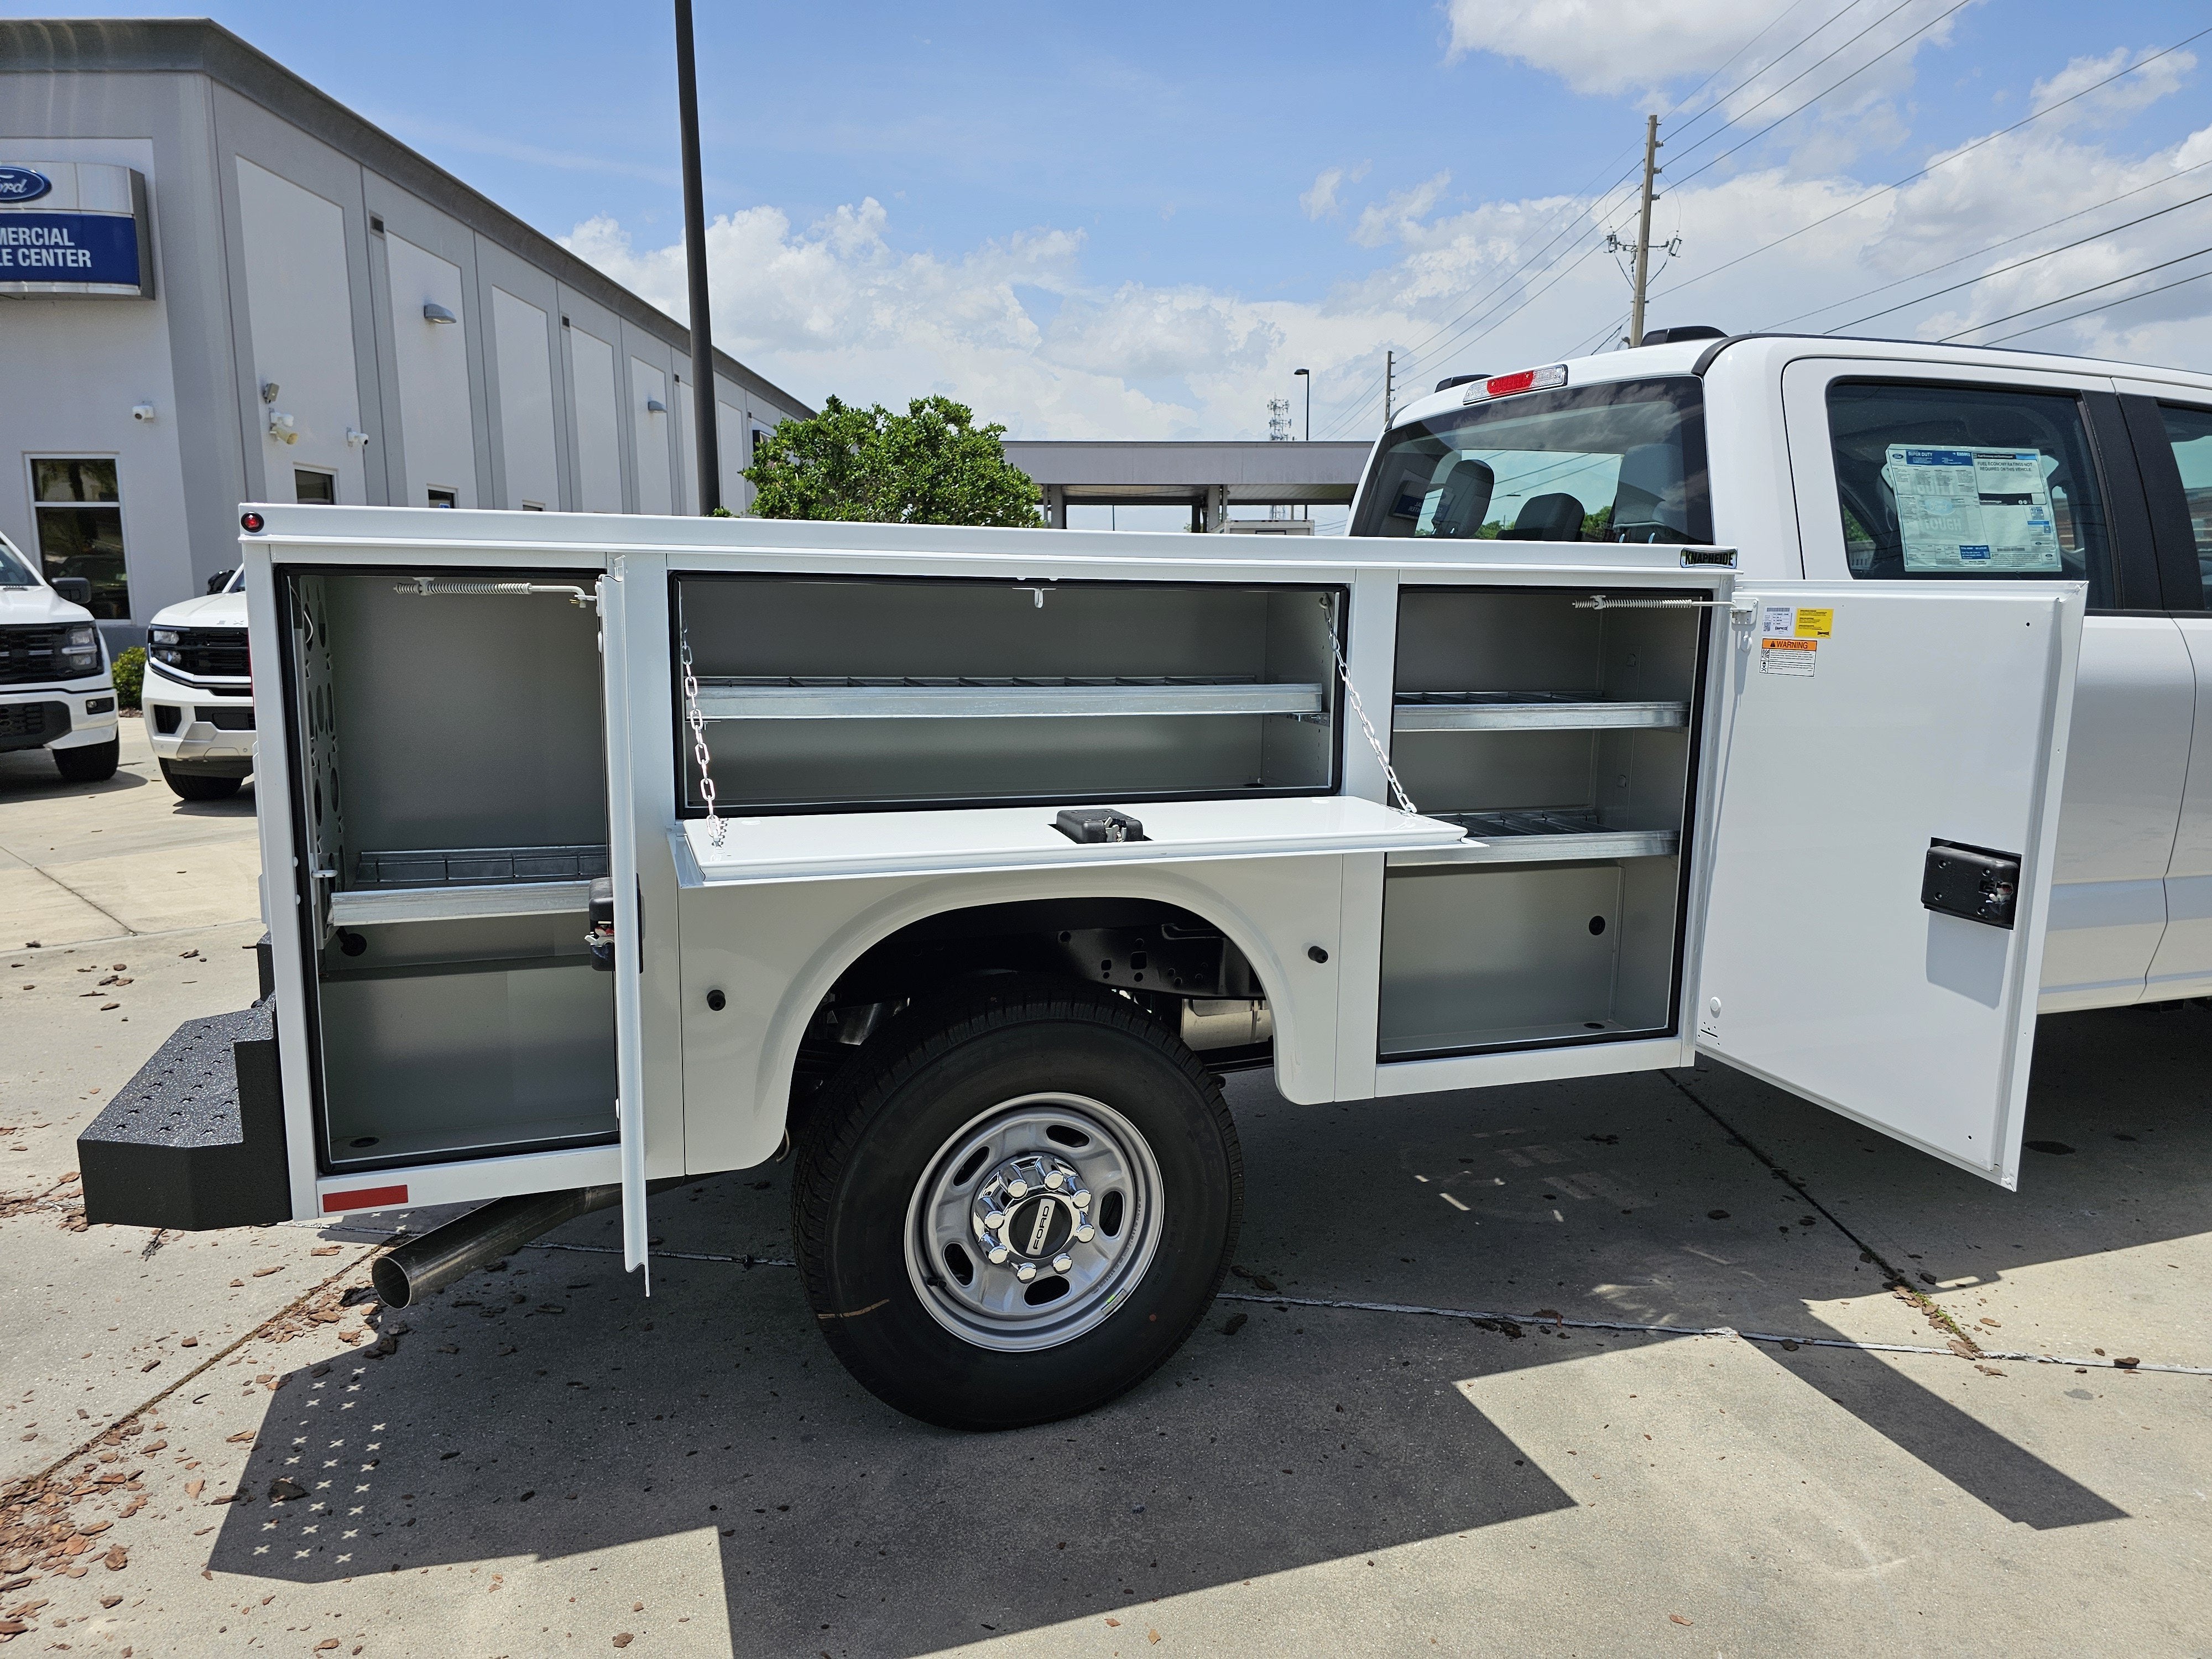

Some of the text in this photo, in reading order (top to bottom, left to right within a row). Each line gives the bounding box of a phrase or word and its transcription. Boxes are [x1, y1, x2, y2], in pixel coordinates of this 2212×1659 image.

[0, 175, 28, 194] ord
[18, 248, 92, 268] CENTER
[1685, 550, 1734, 566] KNAPHEIDE
[1776, 640, 1808, 649] WARNING
[1032, 1206, 1050, 1250] FORD
